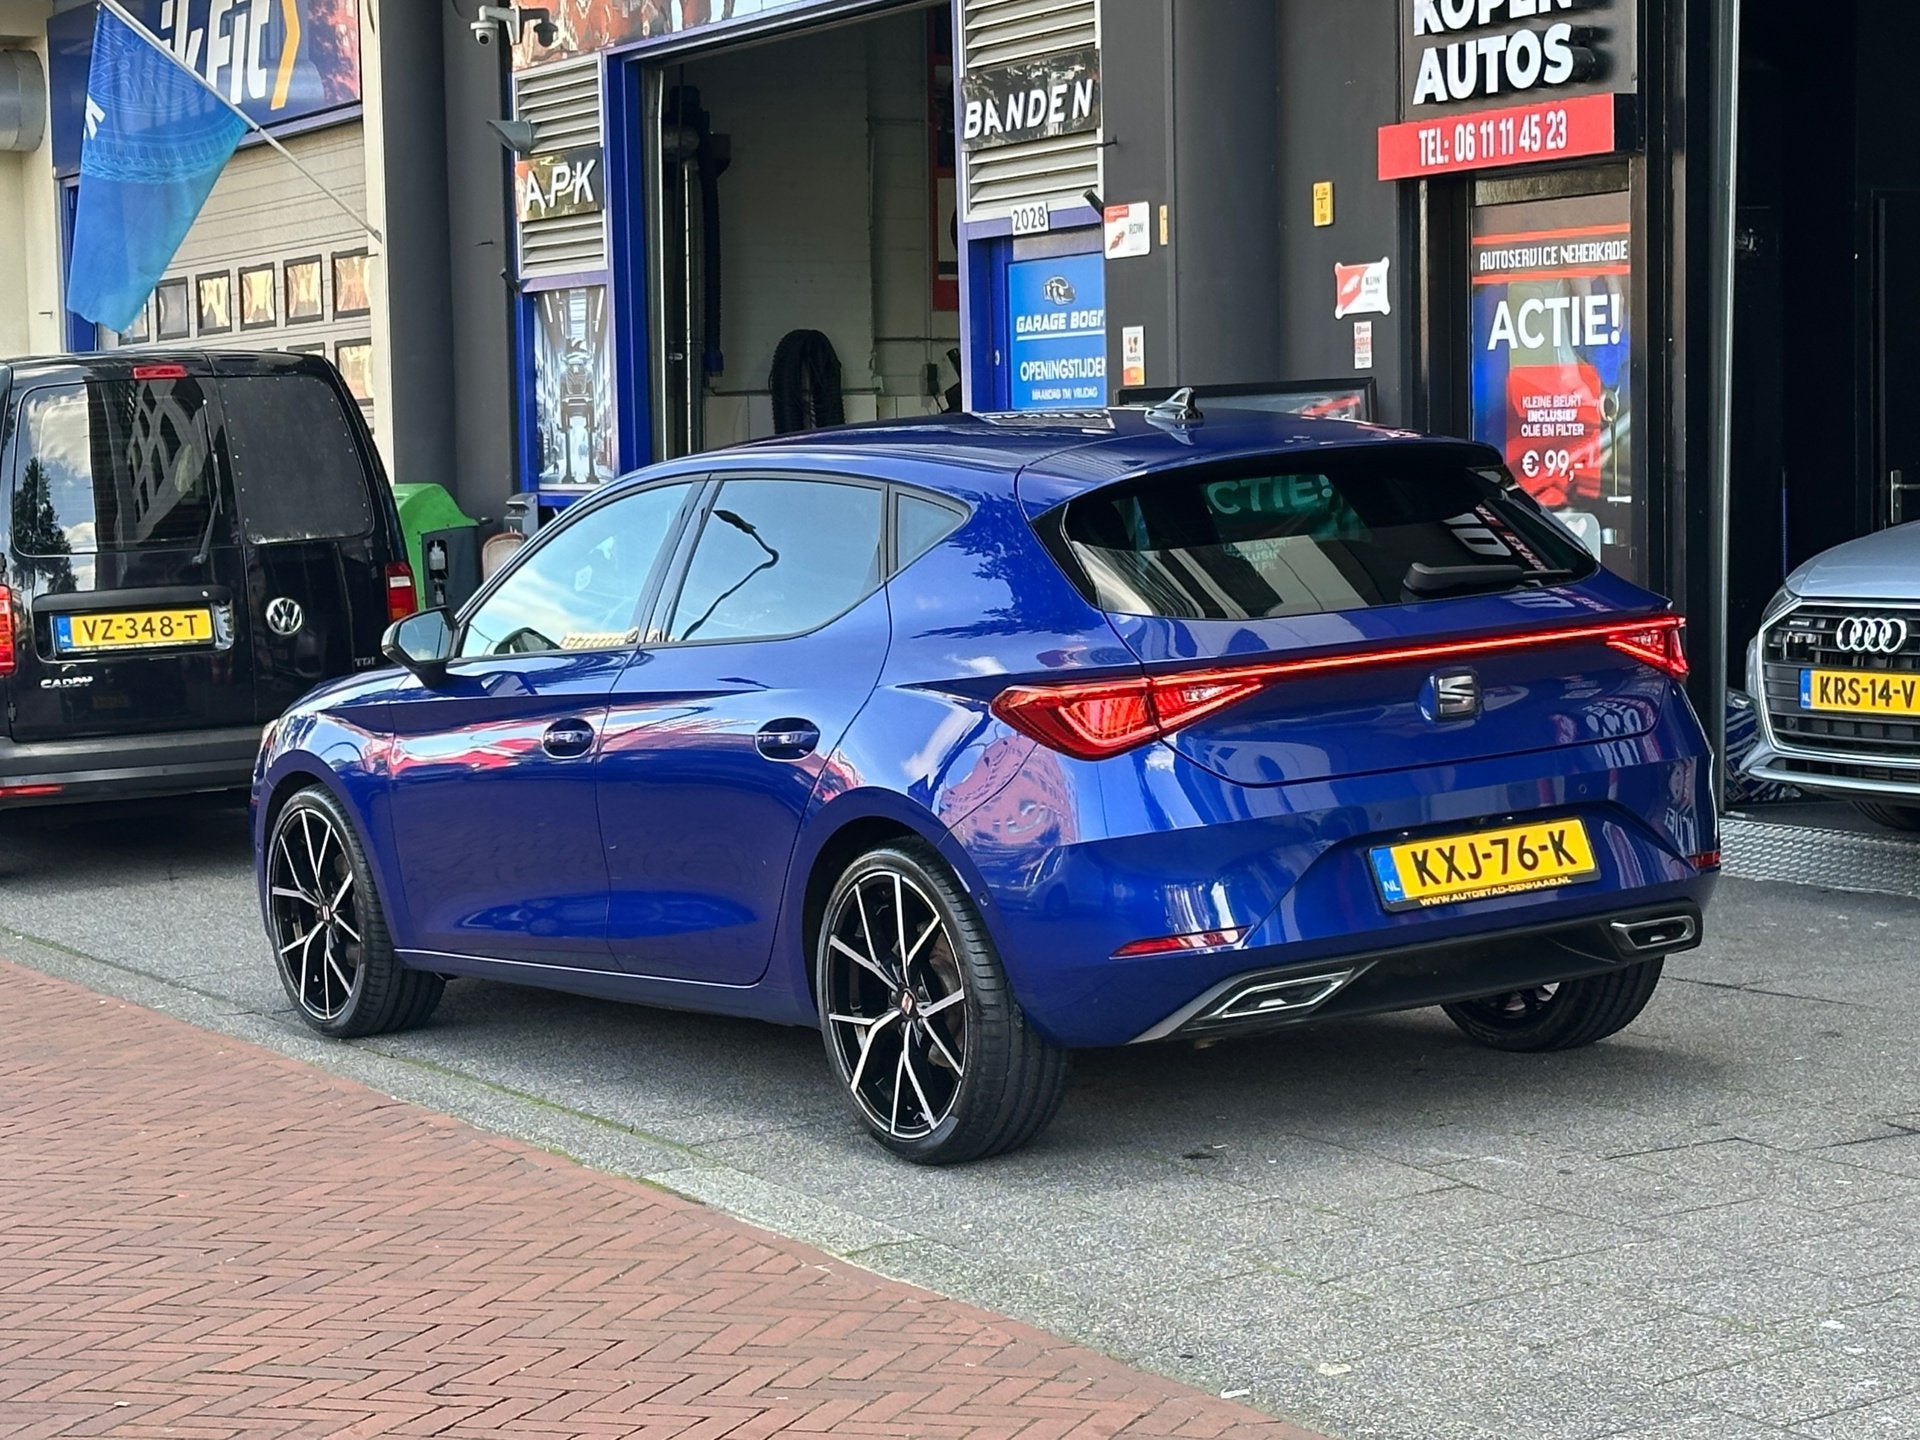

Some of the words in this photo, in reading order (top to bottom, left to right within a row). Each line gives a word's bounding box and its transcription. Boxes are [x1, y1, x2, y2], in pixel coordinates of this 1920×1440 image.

[1413, 23, 1573, 105] AUTOS
[963, 79, 1093, 139] BANDEN
[1418, 127, 1449, 166] TEL:
[1454, 122, 1475, 163] 06
[1480, 120, 1495, 158] 11
[1500, 116, 1514, 155] 11
[1519, 111, 1541, 152] 45
[1546, 109, 1567, 150] 23
[525, 159, 596, 211] APK
[1013, 206, 1046, 231] 2028
[1480, 246, 1558, 271] AUTOSERVICE
[1560, 240, 1628, 264] NEHERKADE
[1016, 313, 1067, 333] GARAGE
[1487, 293, 1620, 350] ACTIE!
[1522, 395, 1551, 408] KLEINE
[1553, 394, 1582, 407] BEURT
[1528, 409, 1577, 422] INCLUSIEF
[1521, 424, 1541, 437] OLIE
[1542, 424, 1554, 437] EN
[1556, 423, 1584, 436] FILTER
[1522, 450, 1539, 477] €
[1545, 450, 1583, 481] 99,-
[1207, 474, 1333, 514] CTIE!
[82, 614, 198, 641] VZ-348-T
[1820, 676, 1916, 708] KRS-14-V
[1411, 829, 1577, 887] KXJ-76-K
[1384, 880, 1400, 892] NL
